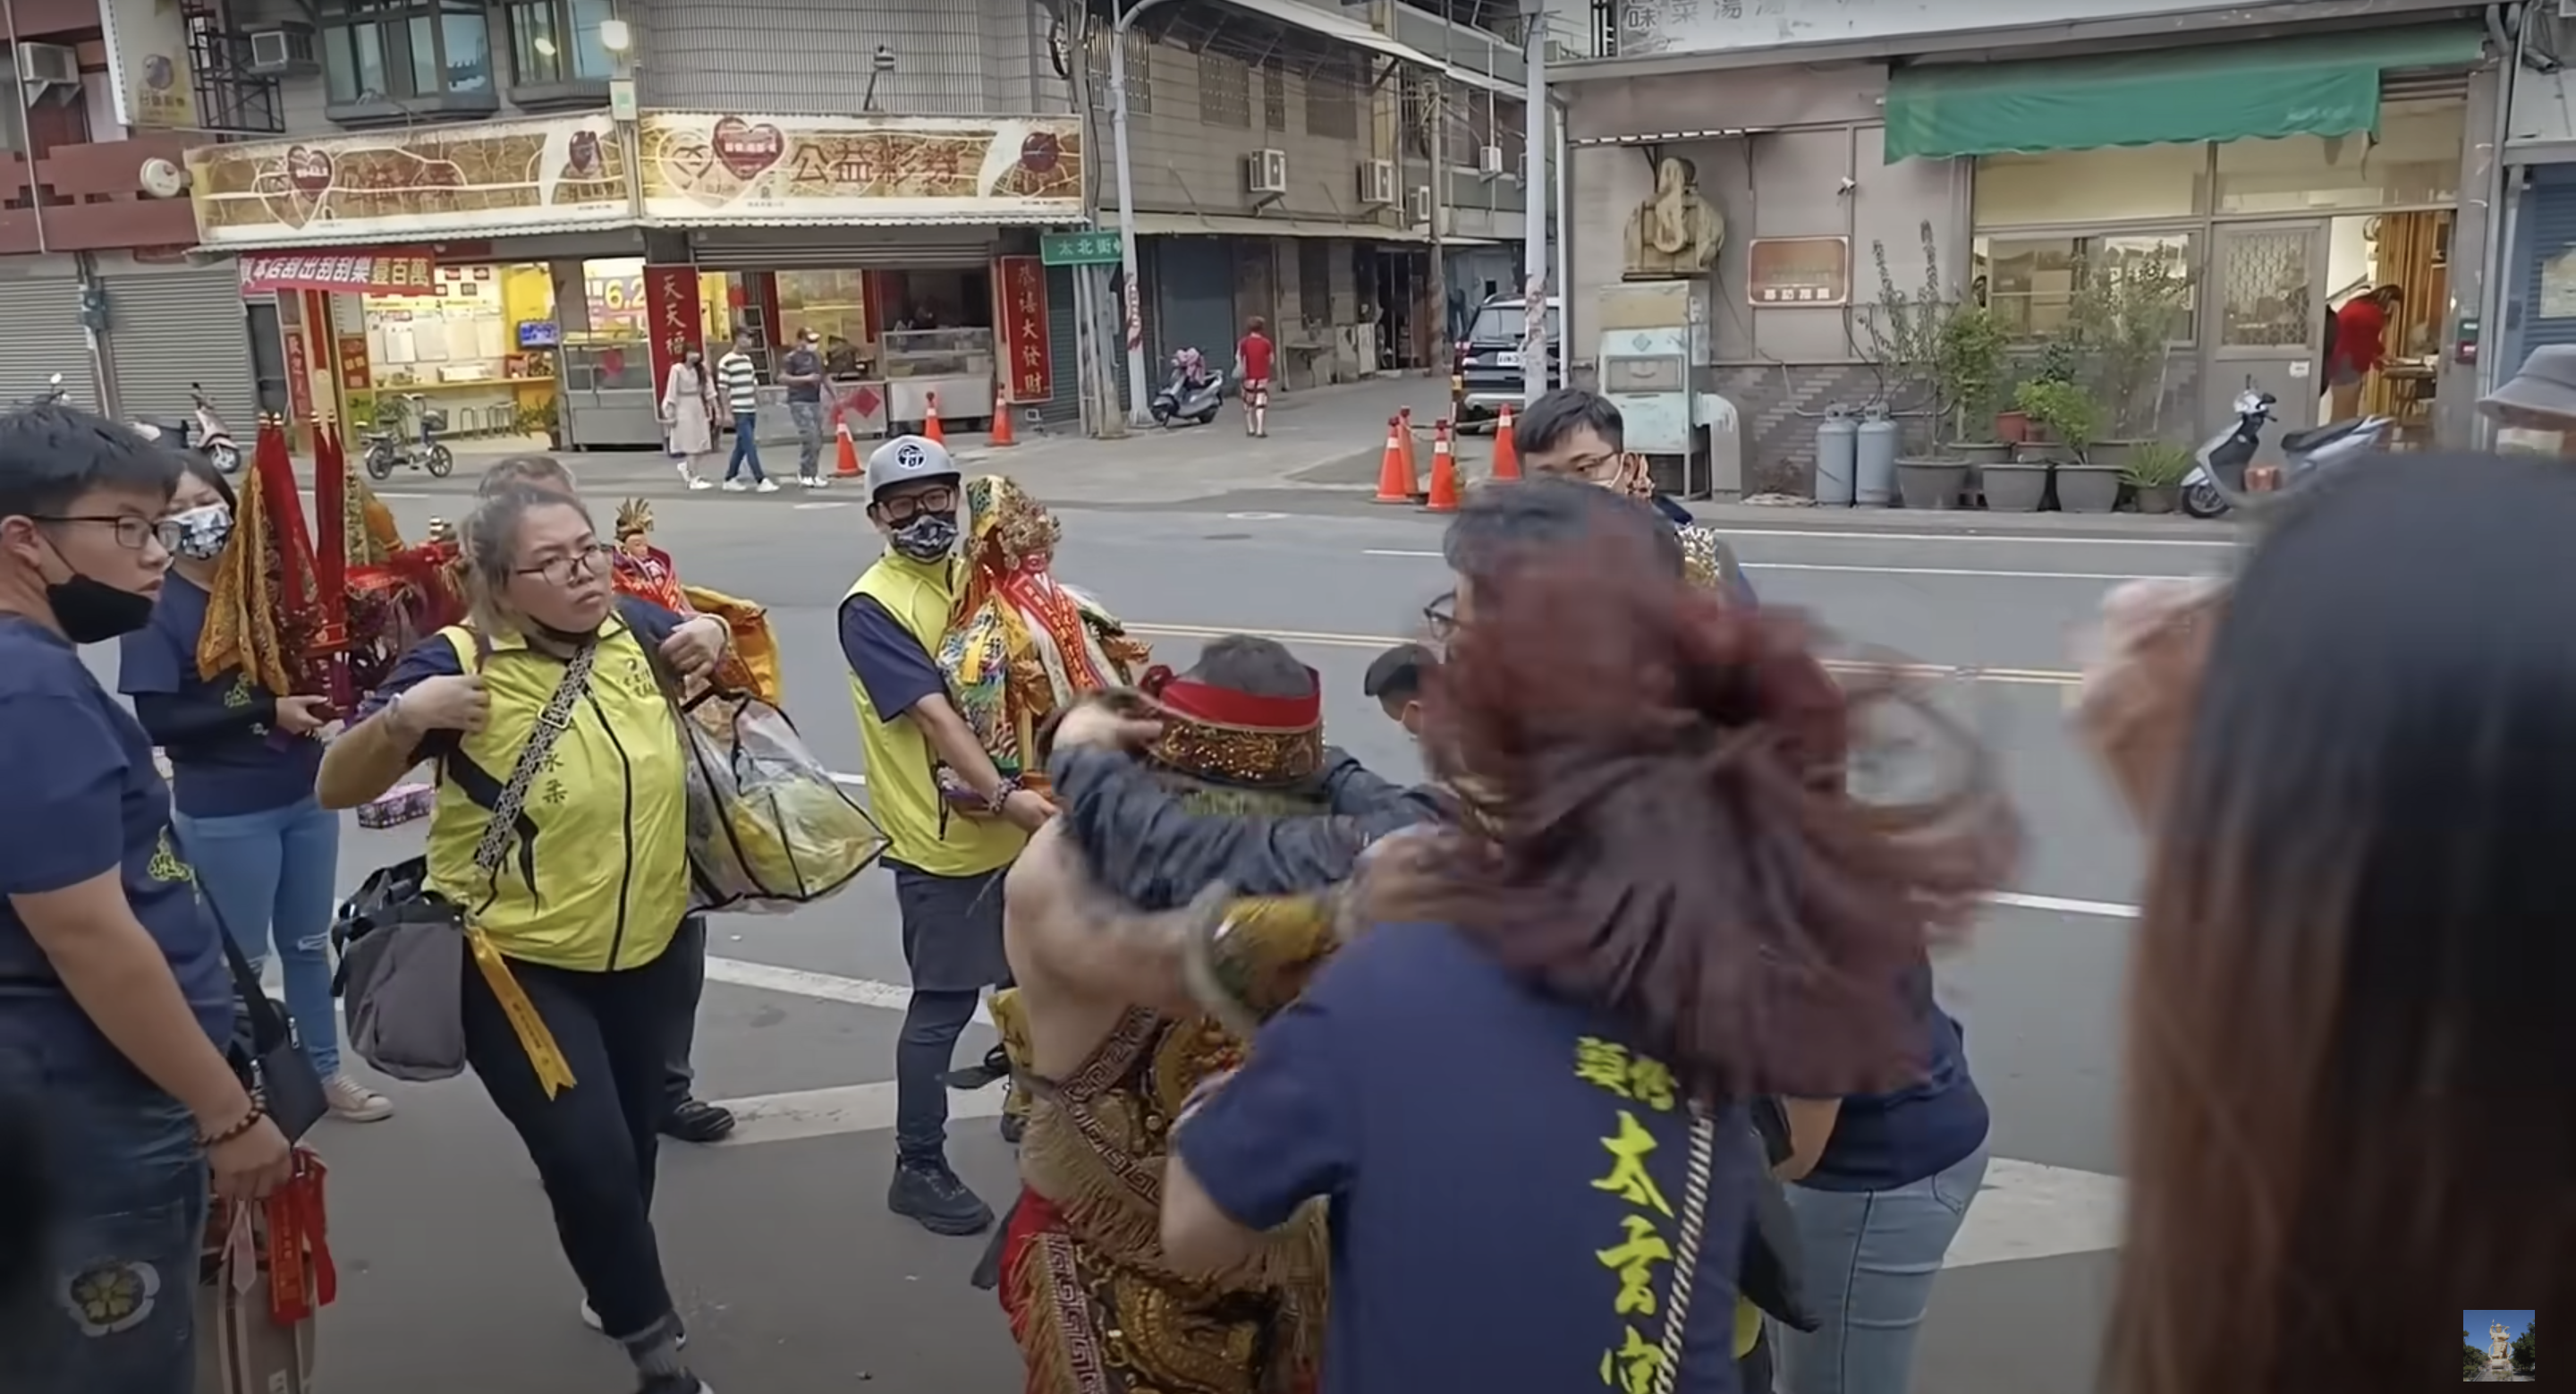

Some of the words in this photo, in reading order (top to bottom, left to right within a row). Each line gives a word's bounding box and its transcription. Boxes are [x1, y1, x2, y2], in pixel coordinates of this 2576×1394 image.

[791, 140, 959, 186] 公益彩券
[664, 274, 687, 363] 天天福
